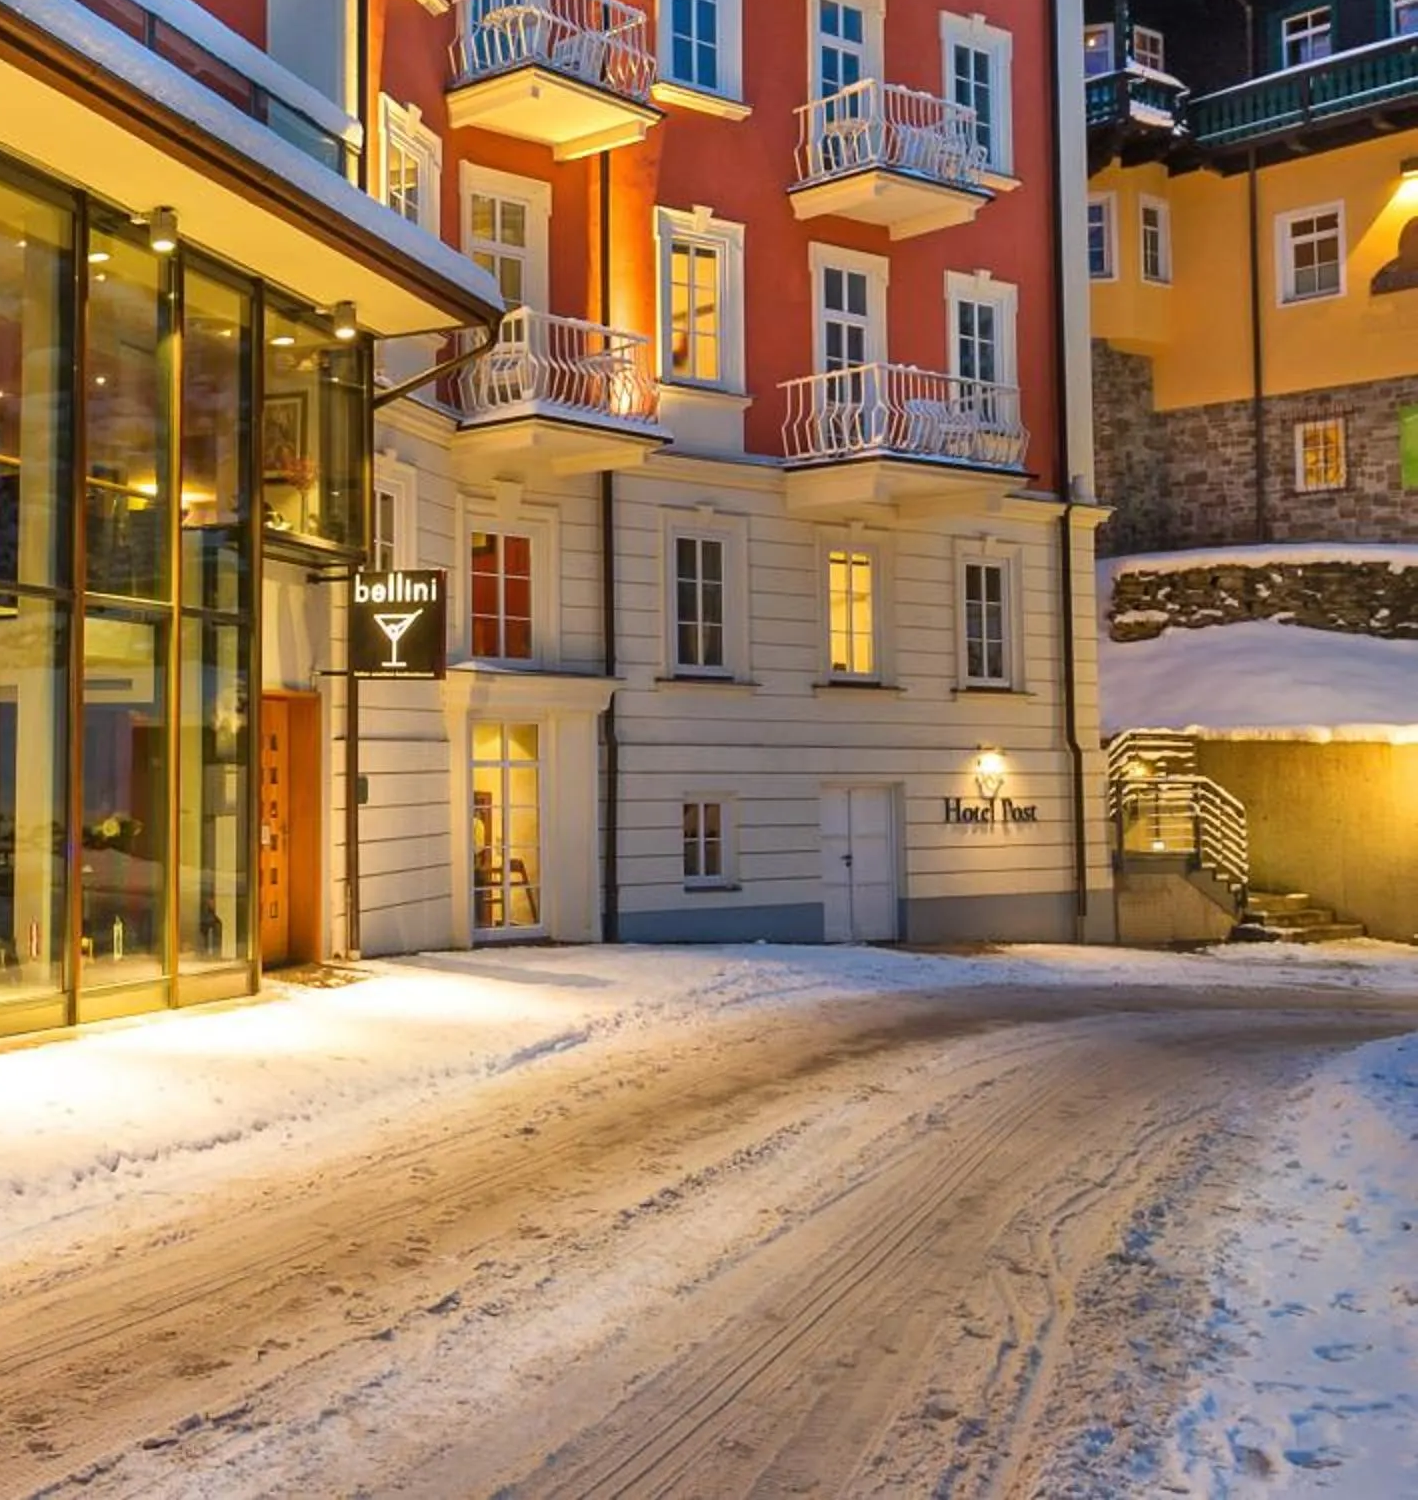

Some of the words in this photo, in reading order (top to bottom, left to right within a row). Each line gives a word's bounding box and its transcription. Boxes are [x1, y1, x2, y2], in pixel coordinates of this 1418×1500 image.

[354, 571, 437, 603] bellini
[944, 797, 995, 823] Hotel
[1000, 797, 1038, 823] Post
